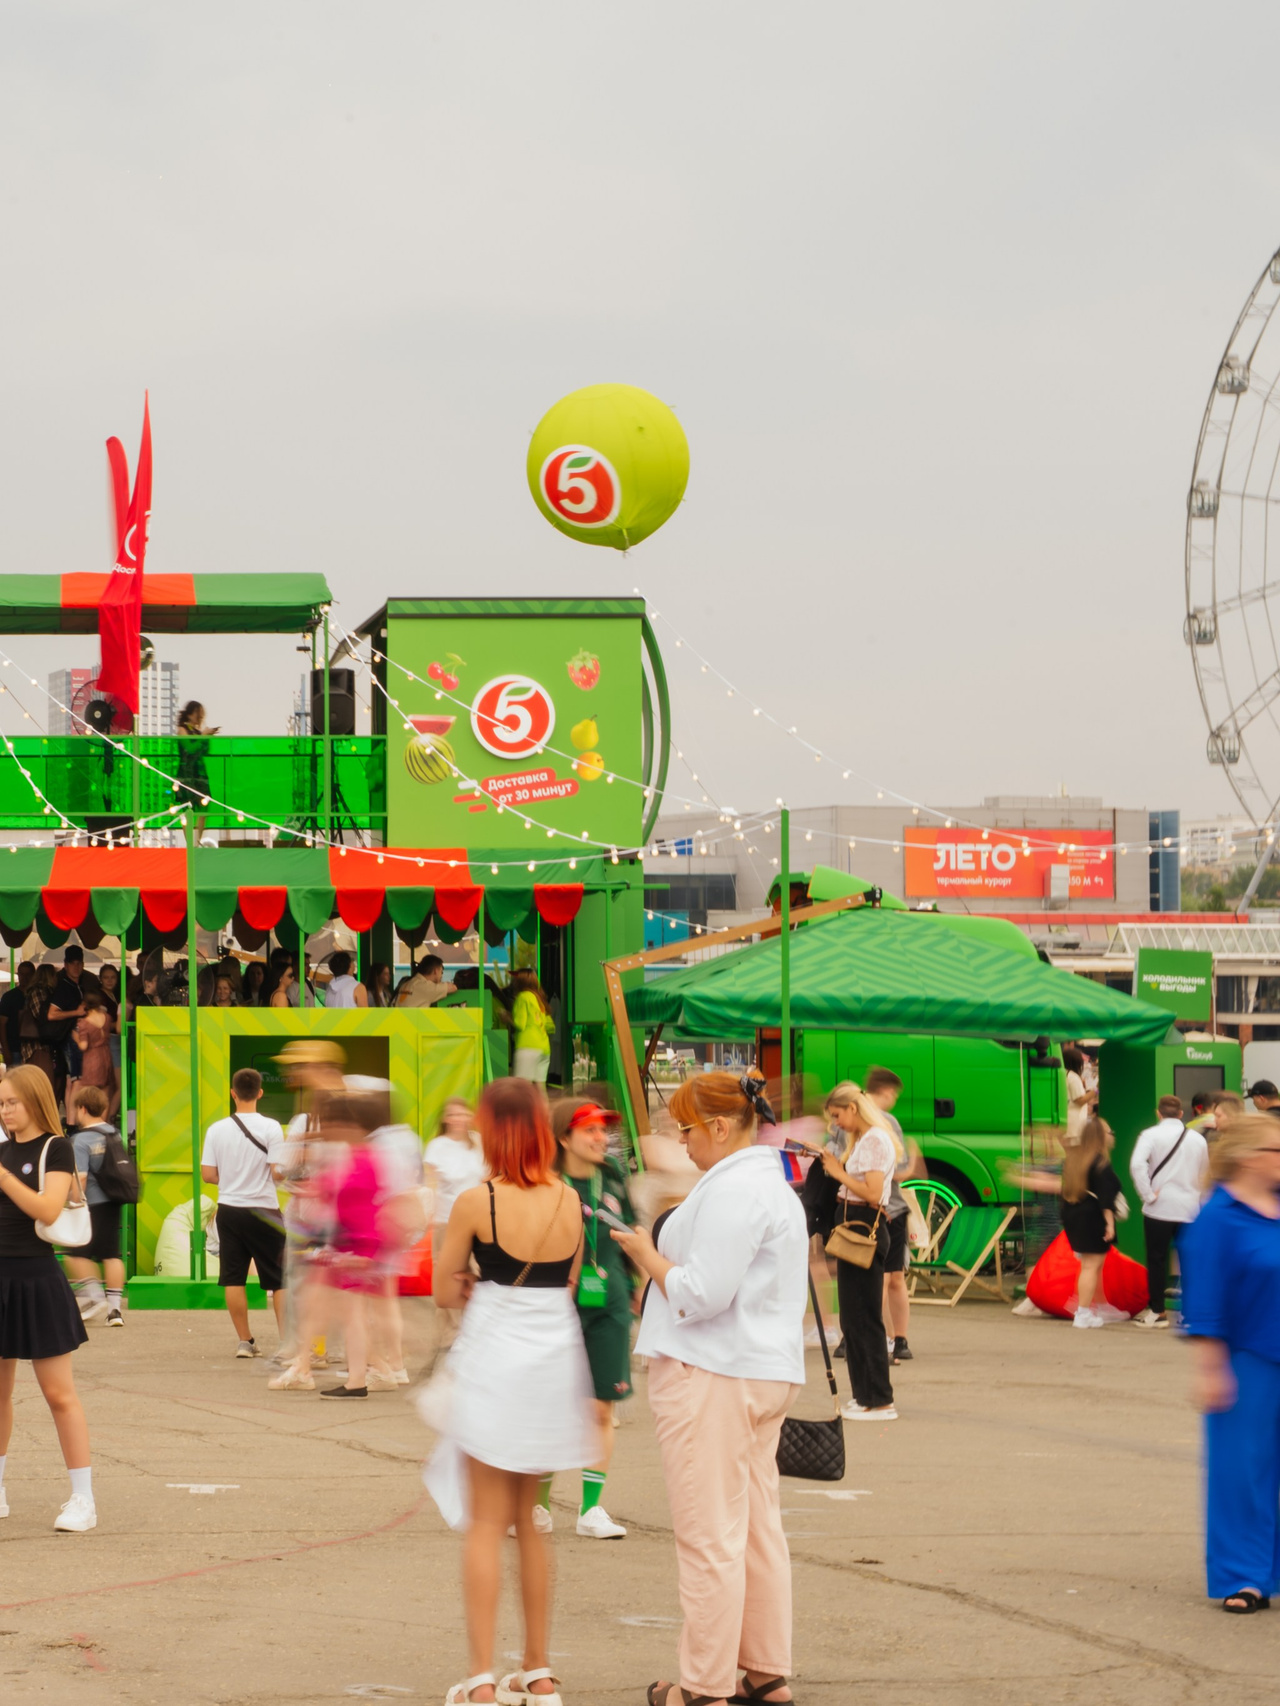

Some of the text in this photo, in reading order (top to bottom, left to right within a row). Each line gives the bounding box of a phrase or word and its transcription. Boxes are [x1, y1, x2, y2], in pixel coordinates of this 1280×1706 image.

[557, 451, 598, 514] 5
[493, 682, 537, 744] 5
[488, 772, 548, 792] Доставка
[499, 783, 572, 804] от 30 минут
[933, 843, 1016, 871] ЛЕТО
[937, 876, 1012, 887] термальный курорт
